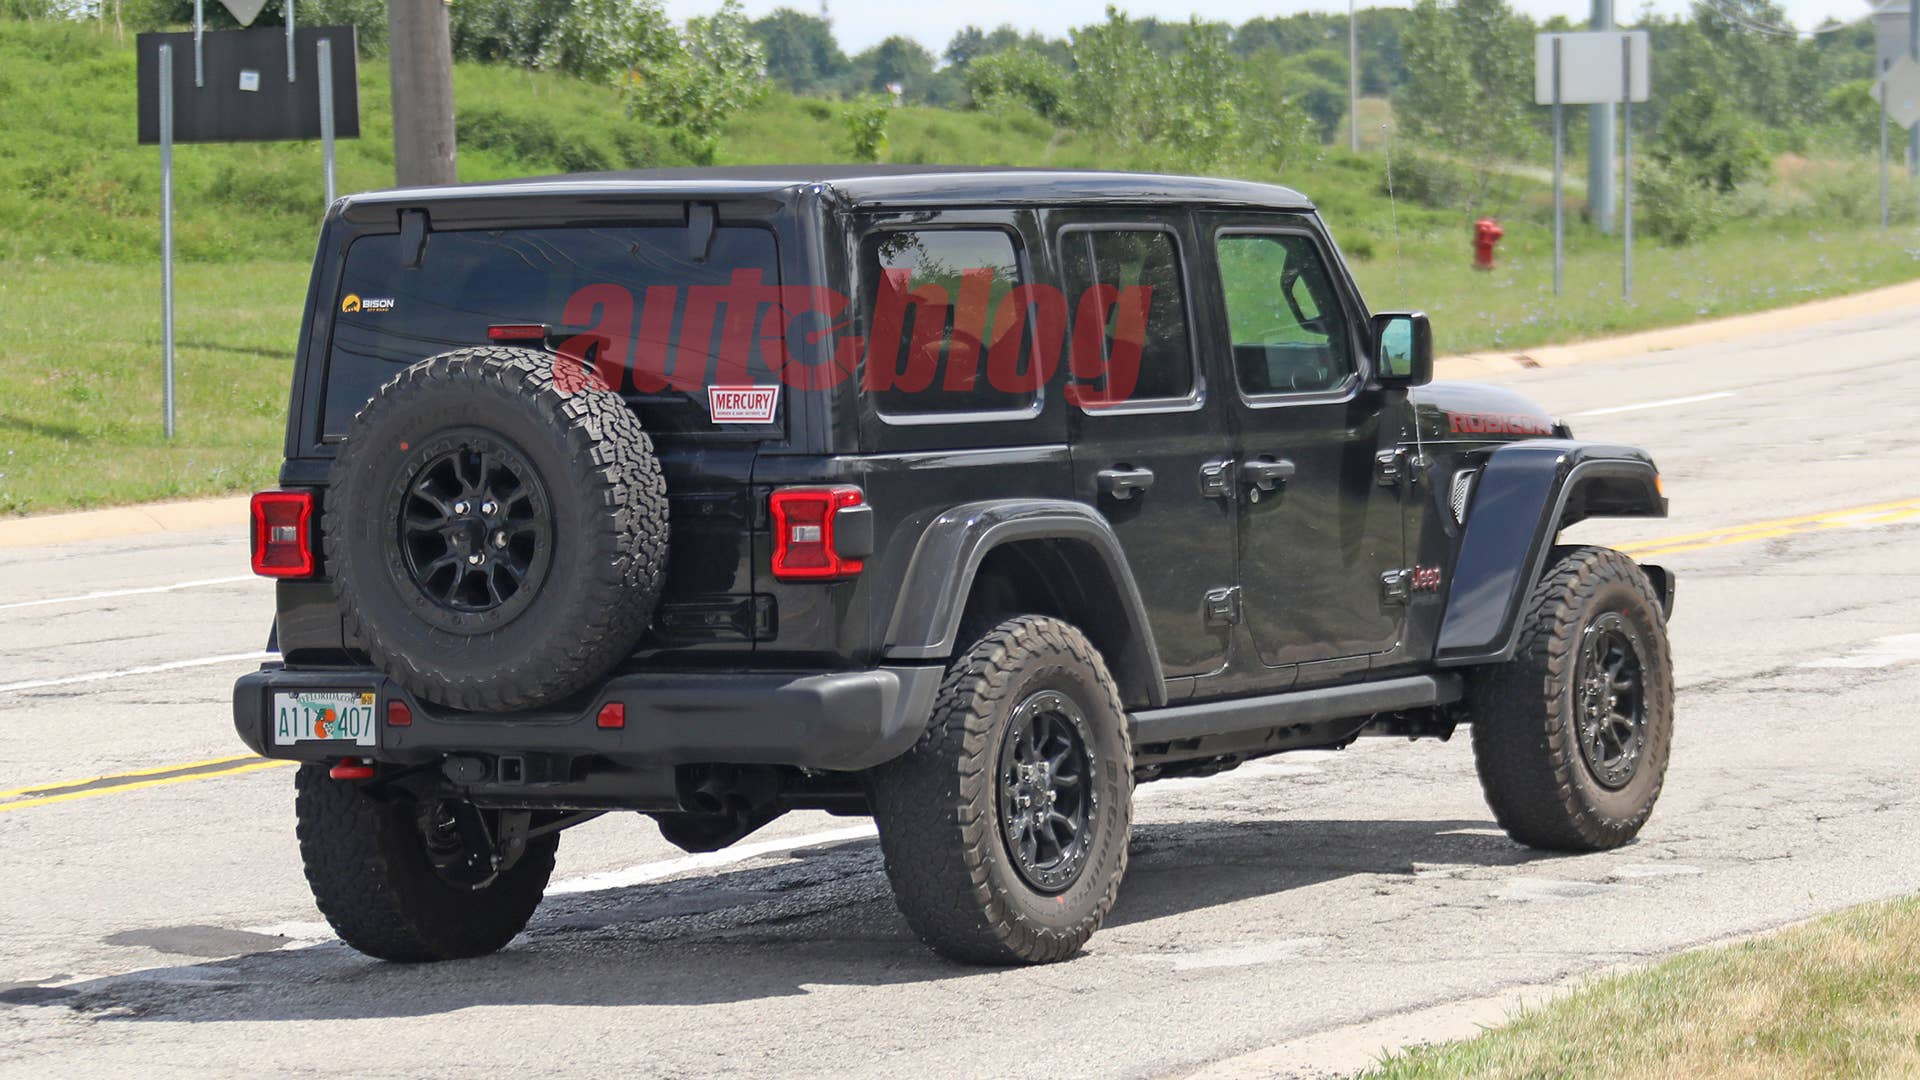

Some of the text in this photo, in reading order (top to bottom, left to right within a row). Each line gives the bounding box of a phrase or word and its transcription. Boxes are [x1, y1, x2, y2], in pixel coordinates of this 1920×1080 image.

[362, 300, 394, 308] BISON
[716, 393, 770, 409] MERCURY
[1449, 412, 1552, 434] RUBICON
